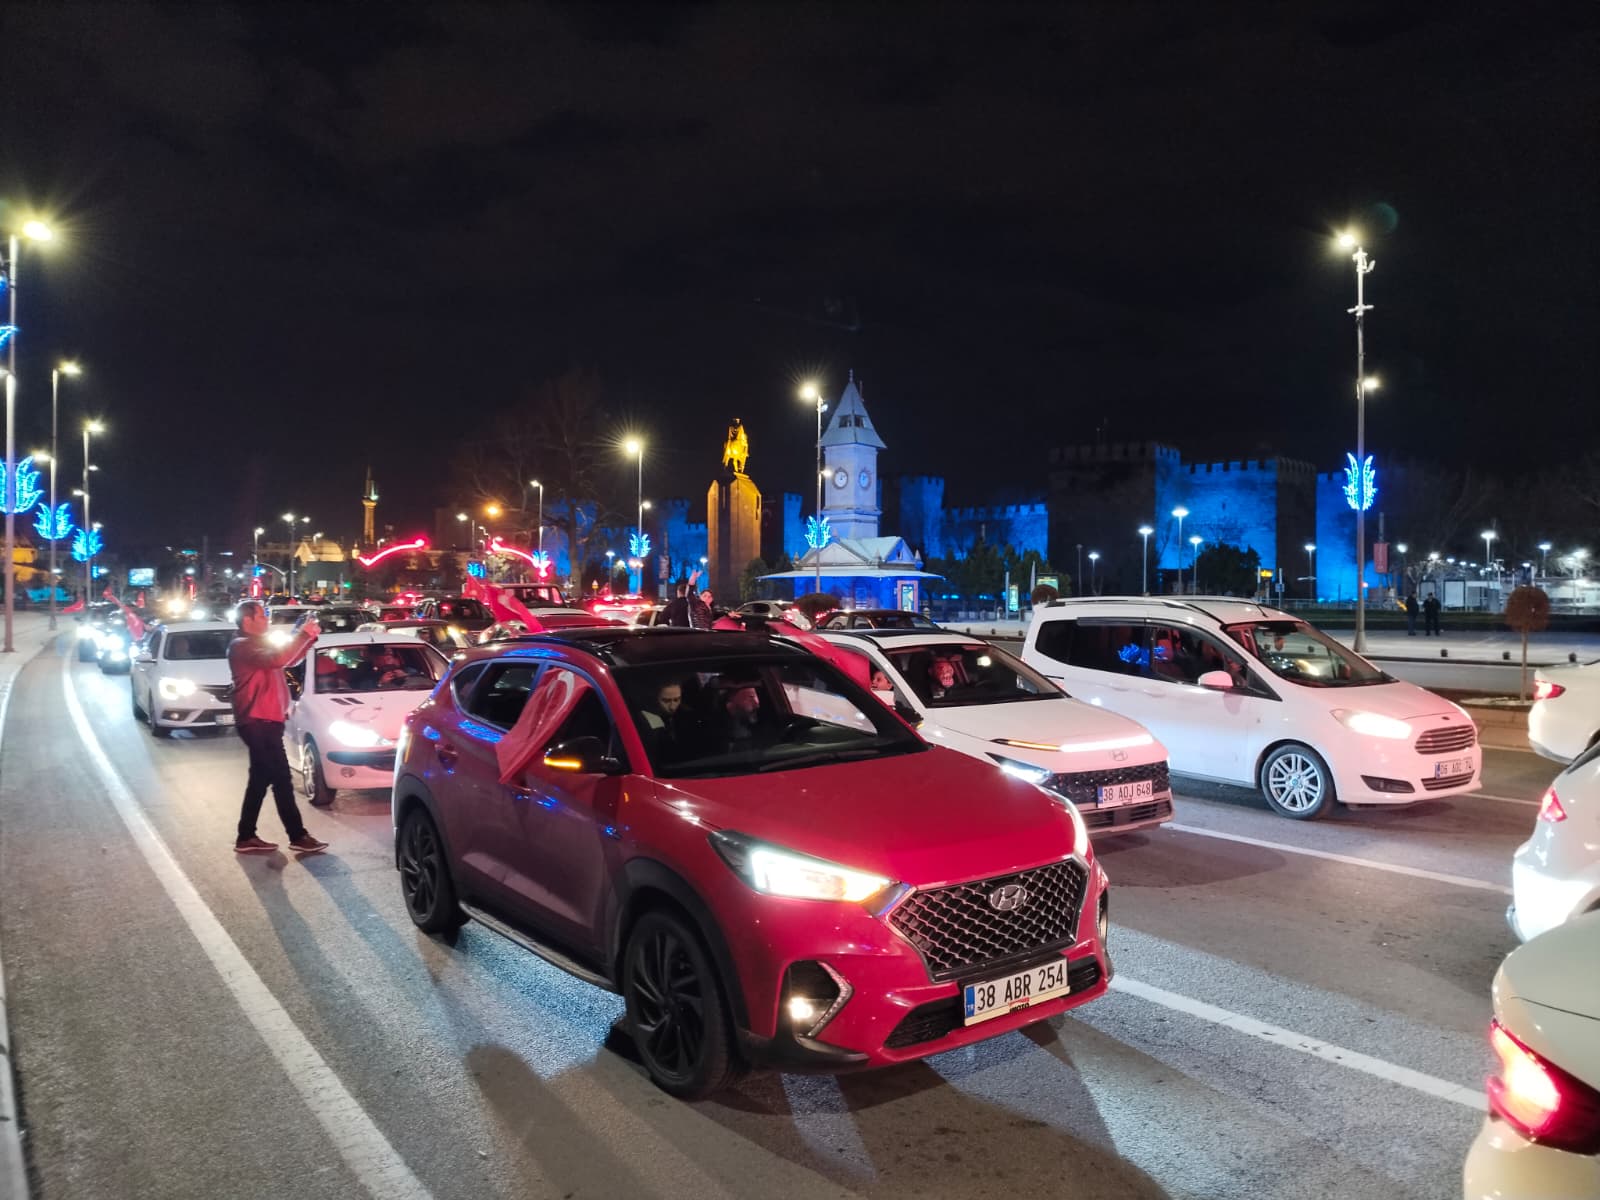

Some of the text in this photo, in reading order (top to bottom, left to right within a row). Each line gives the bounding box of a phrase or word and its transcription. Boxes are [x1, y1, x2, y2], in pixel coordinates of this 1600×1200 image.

[1103, 788, 1114, 801] 38
[1136, 782, 1151, 796] 648
[977, 963, 1064, 1011] 38 ABR 254
